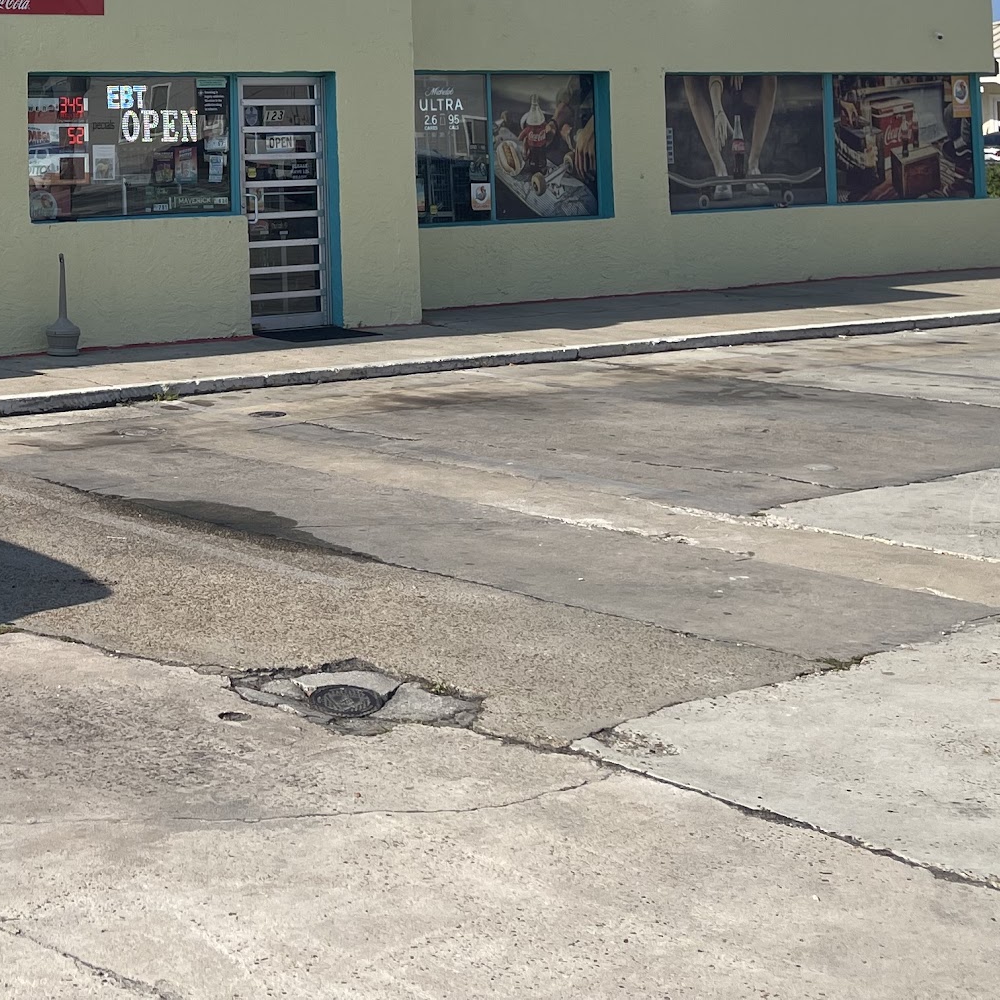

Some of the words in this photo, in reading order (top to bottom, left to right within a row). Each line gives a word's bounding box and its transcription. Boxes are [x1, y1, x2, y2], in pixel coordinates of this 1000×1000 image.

[106, 85, 147, 109] EBT
[419, 98, 464, 111] ULTRA
[60, 97, 84, 114] 345
[265, 110, 284, 121] 123
[448, 114, 460, 125] 95
[121, 109, 199, 143] OPEN
[67, 127, 85, 145] 52
[269, 137, 292, 149] OPEN
